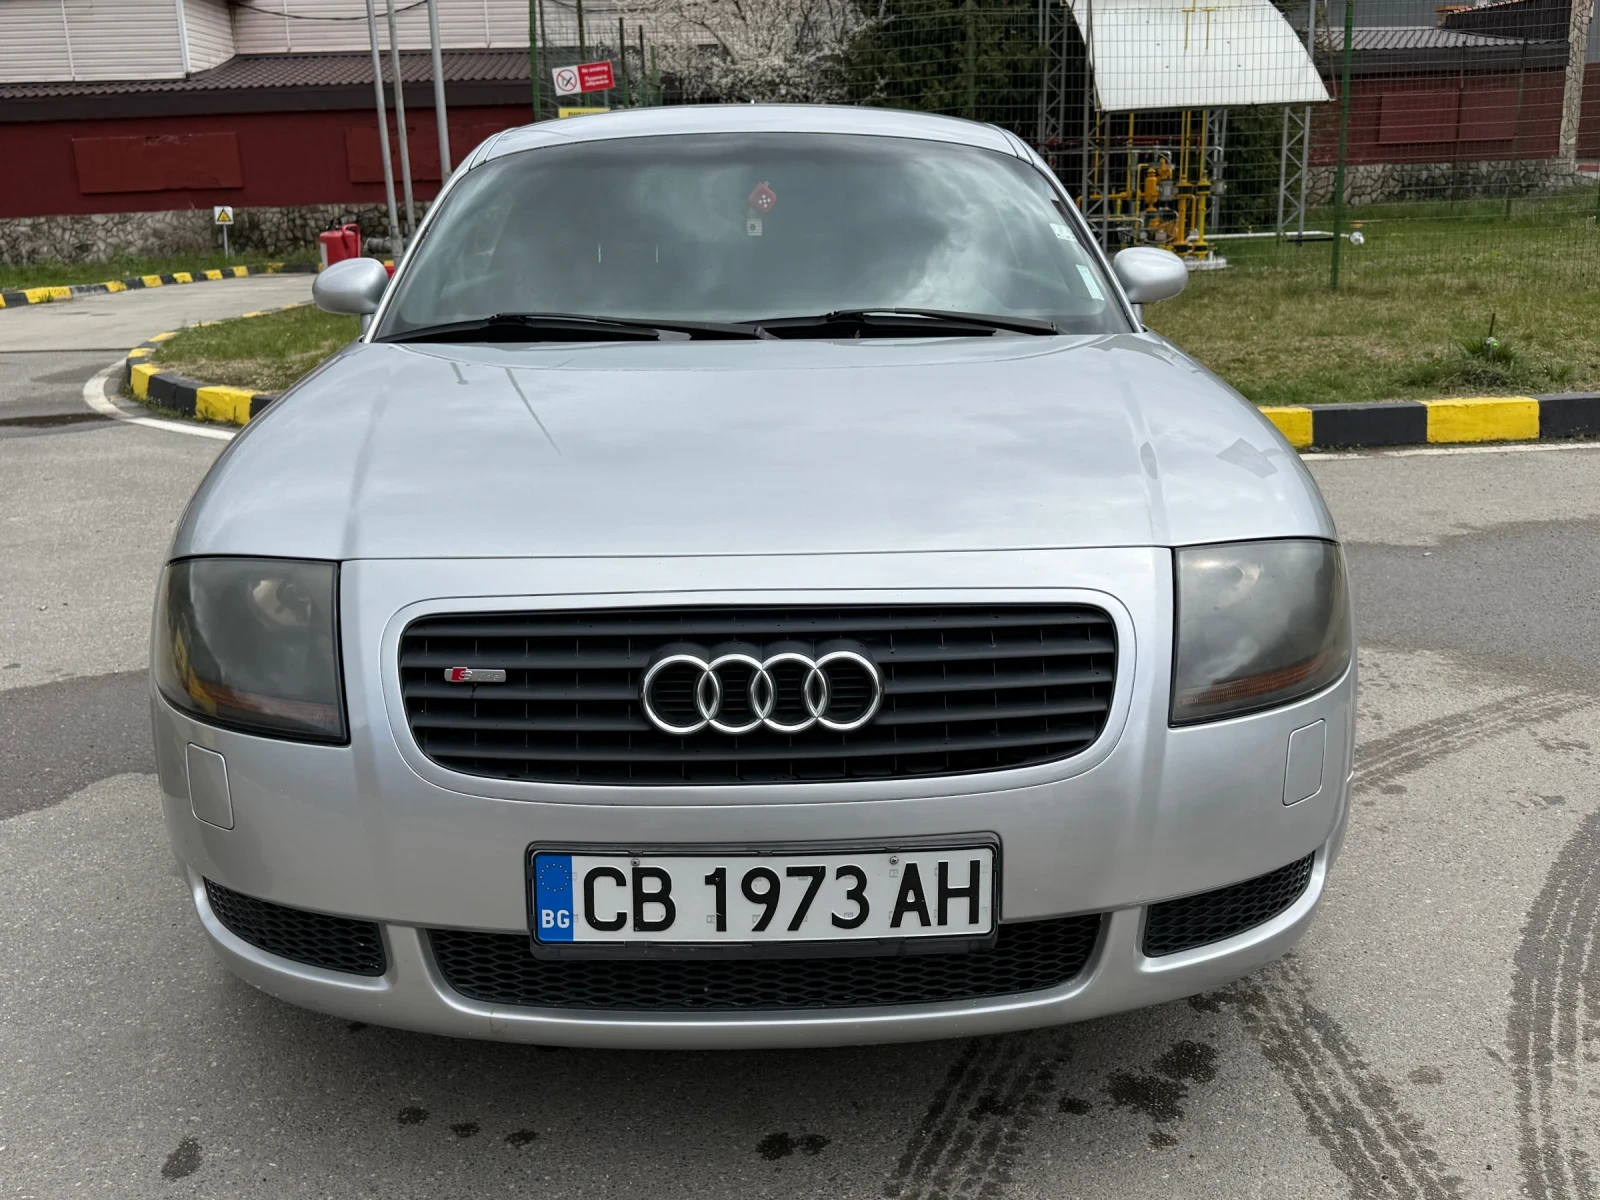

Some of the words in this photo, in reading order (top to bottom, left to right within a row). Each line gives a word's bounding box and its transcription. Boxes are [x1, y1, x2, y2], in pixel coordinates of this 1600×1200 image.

[589, 65, 608, 73] smoking
[583, 866, 676, 932] CB
[705, 864, 870, 932] 1973
[890, 859, 981, 928] AH
[541, 909, 570, 929] BG
